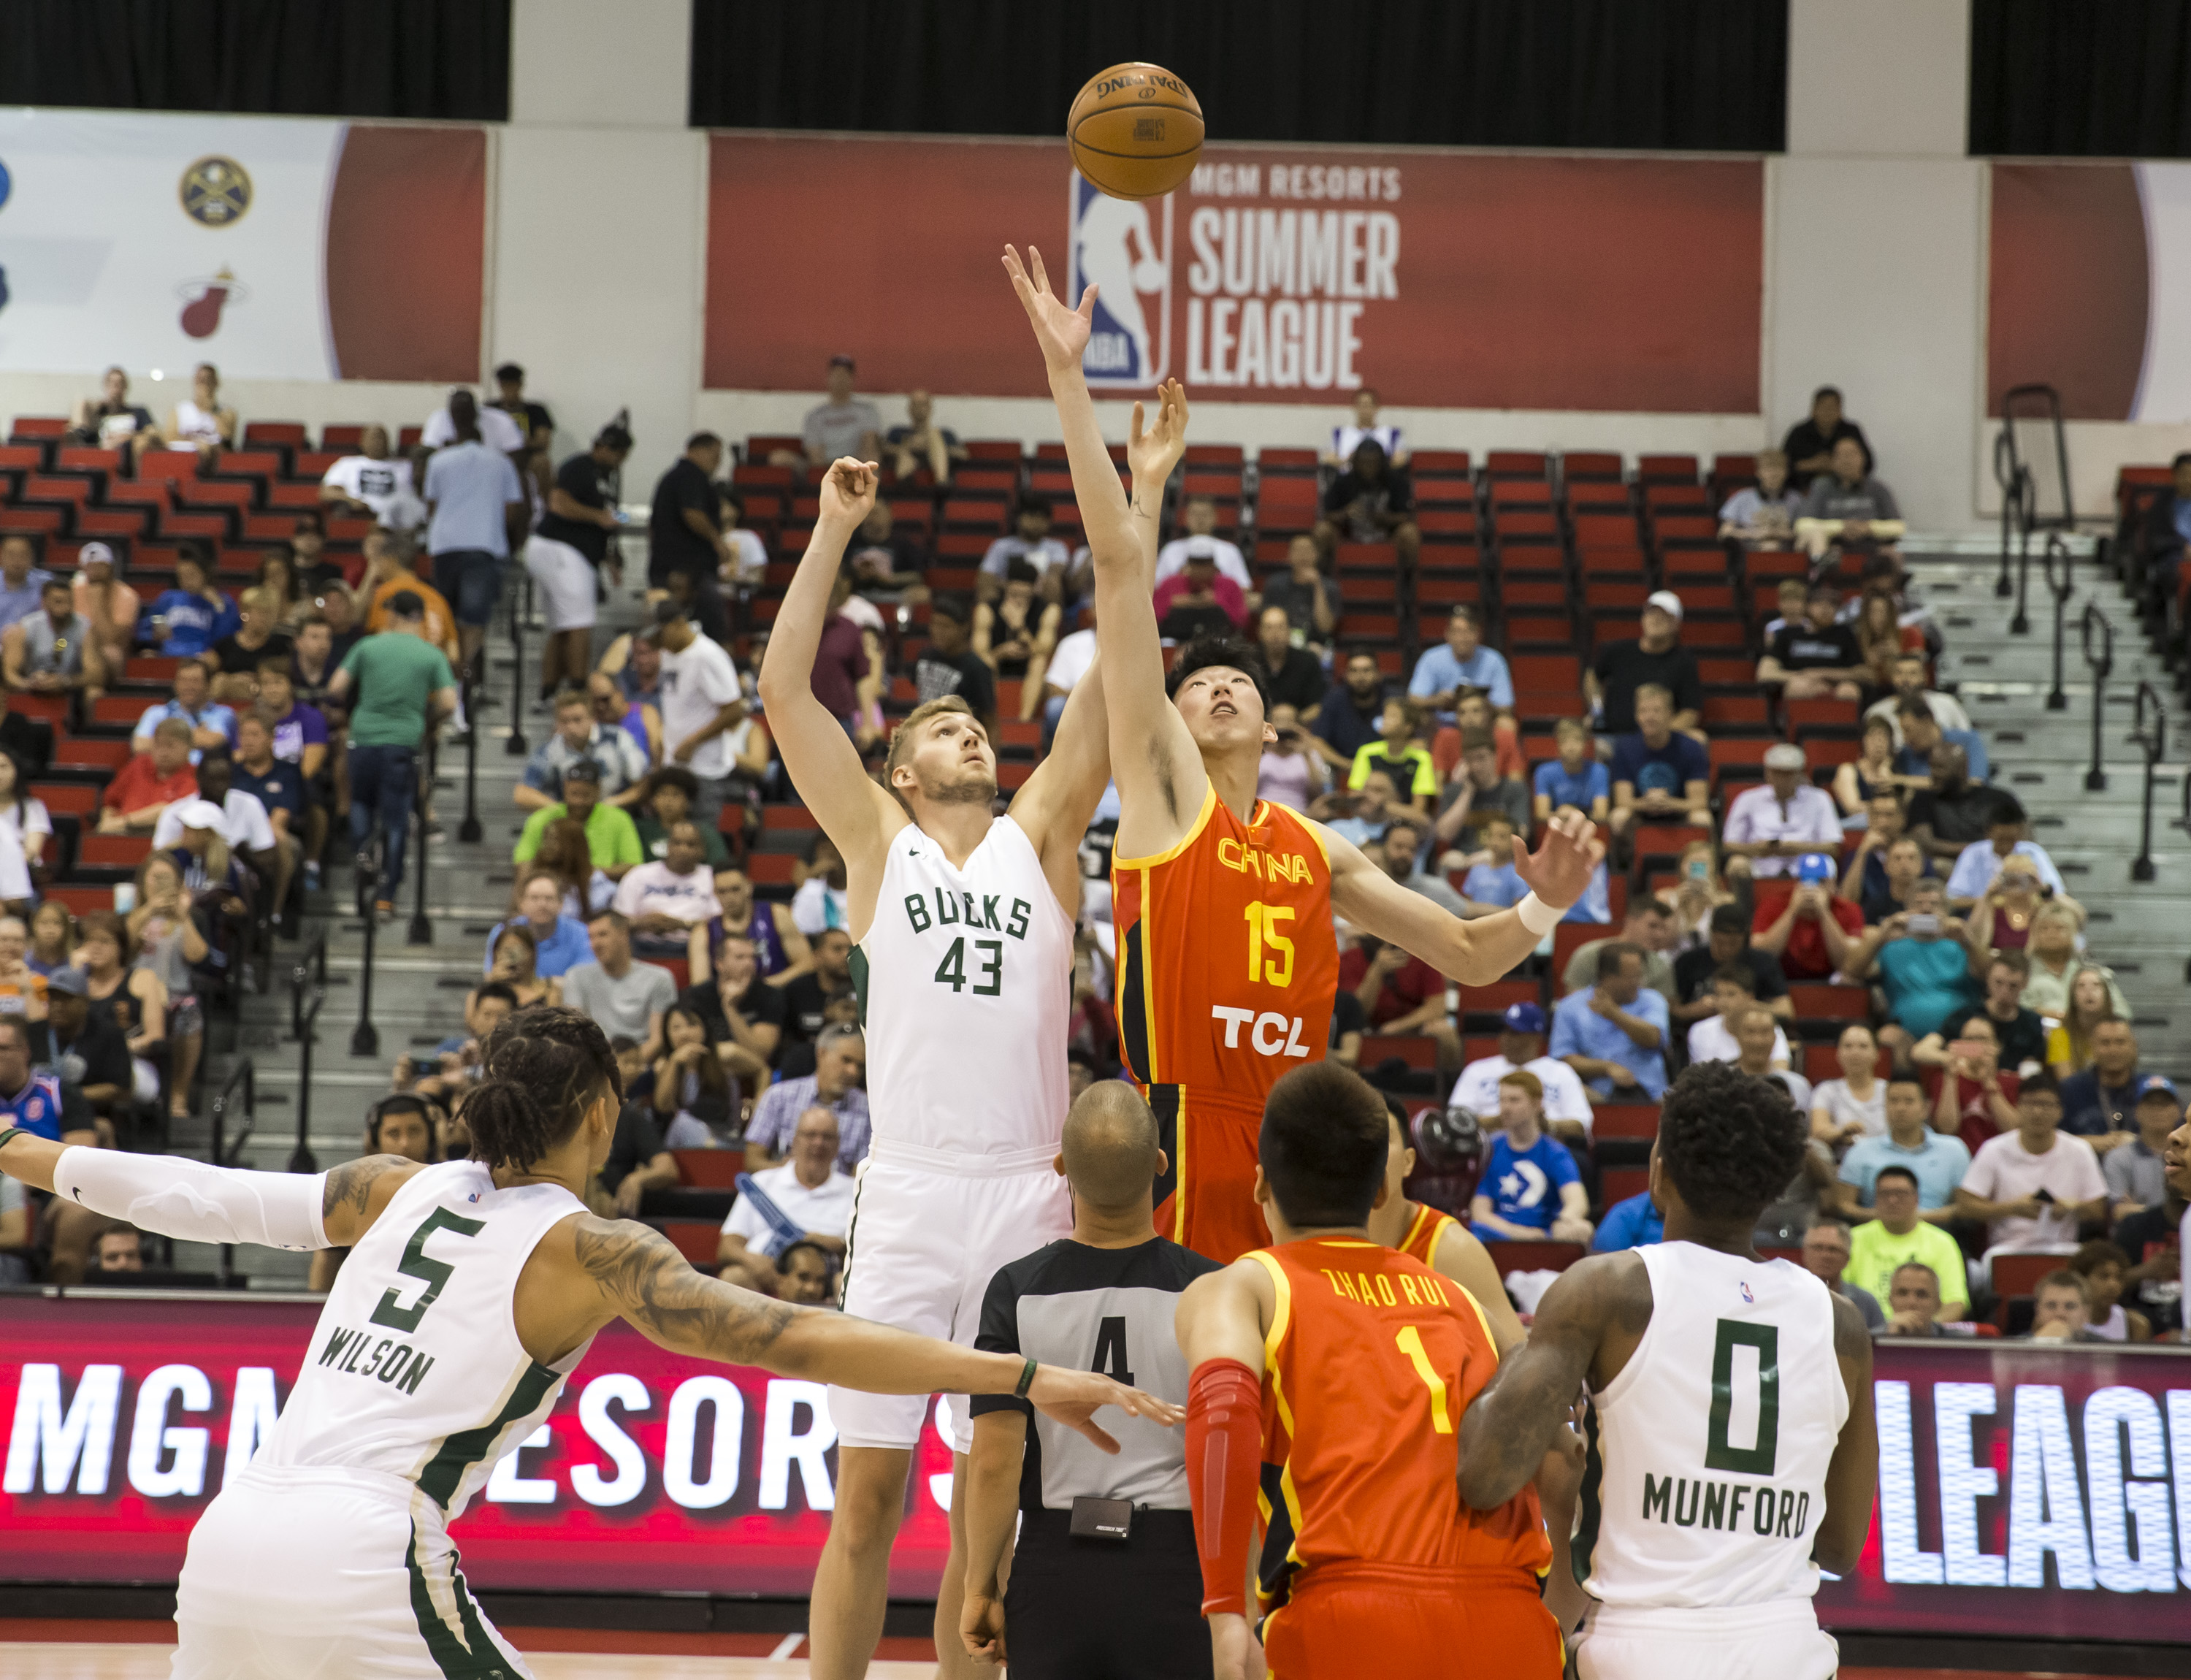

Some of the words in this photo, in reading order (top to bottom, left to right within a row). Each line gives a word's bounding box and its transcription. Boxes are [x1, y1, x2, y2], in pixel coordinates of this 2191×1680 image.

[1190, 163, 1261, 196] MGM
[1269, 164, 1402, 201] RESORTS
[1188, 207, 1400, 299] SUMMER
[1186, 297, 1363, 389] LEAGUE
[904, 887, 1031, 941] BUCKS
[1244, 901, 1296, 988] 15
[934, 937, 1003, 996] 43
[1212, 1005, 1310, 1057] TCL
[369, 1205, 488, 1334] 5
[1320, 1269, 1397, 1307] ZHAO
[1399, 1274, 1450, 1307] RUI
[318, 1326, 435, 1396] WILSON
[1090, 1316, 1134, 1386] 4
[1395, 1326, 1453, 1434] 1
[1643, 1473, 1810, 1540] MUNFORD
